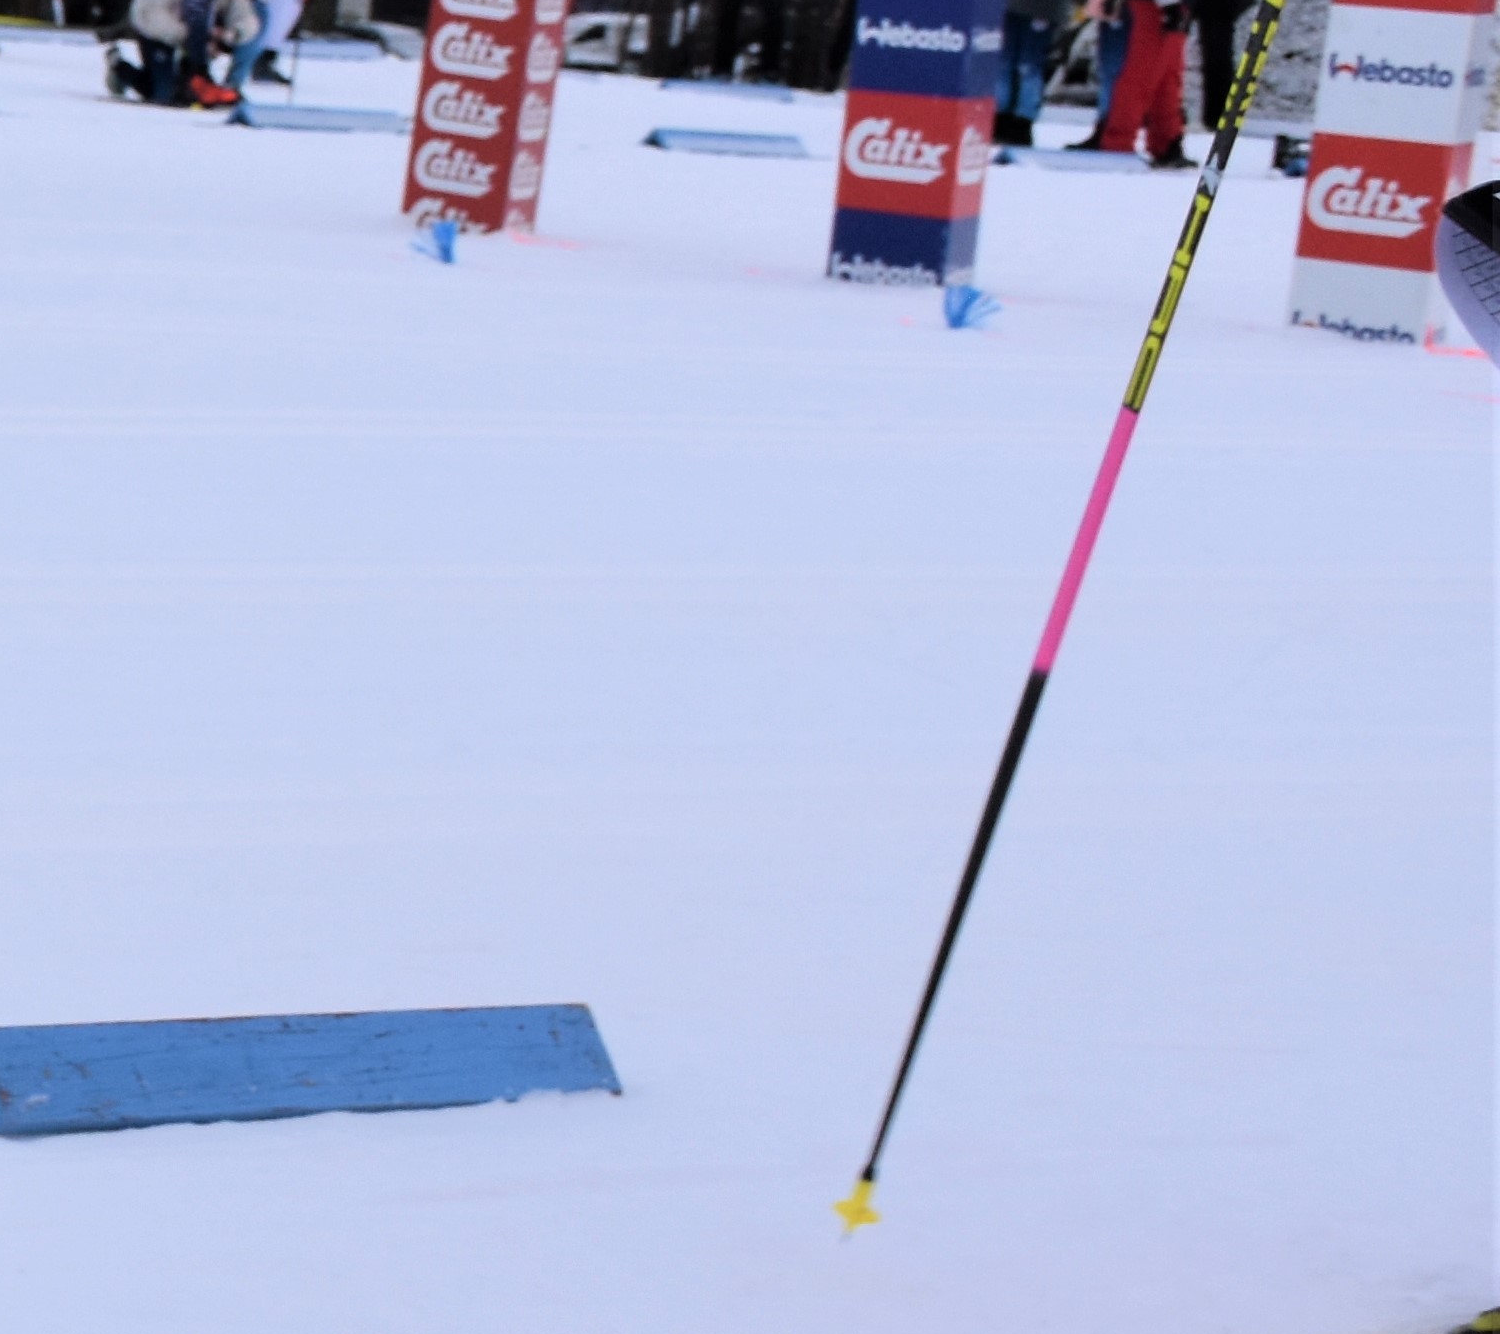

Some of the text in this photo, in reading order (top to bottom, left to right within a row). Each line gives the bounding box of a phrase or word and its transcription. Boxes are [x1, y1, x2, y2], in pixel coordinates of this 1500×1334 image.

[430, 21, 516, 81] Calix
[857, 15, 966, 53] Webasto
[1329, 53, 1455, 89] Webasto
[421, 80, 505, 139] Calix
[413, 139, 497, 198] Calix
[844, 117, 949, 185] Calix
[1305, 165, 1432, 240] Calix
